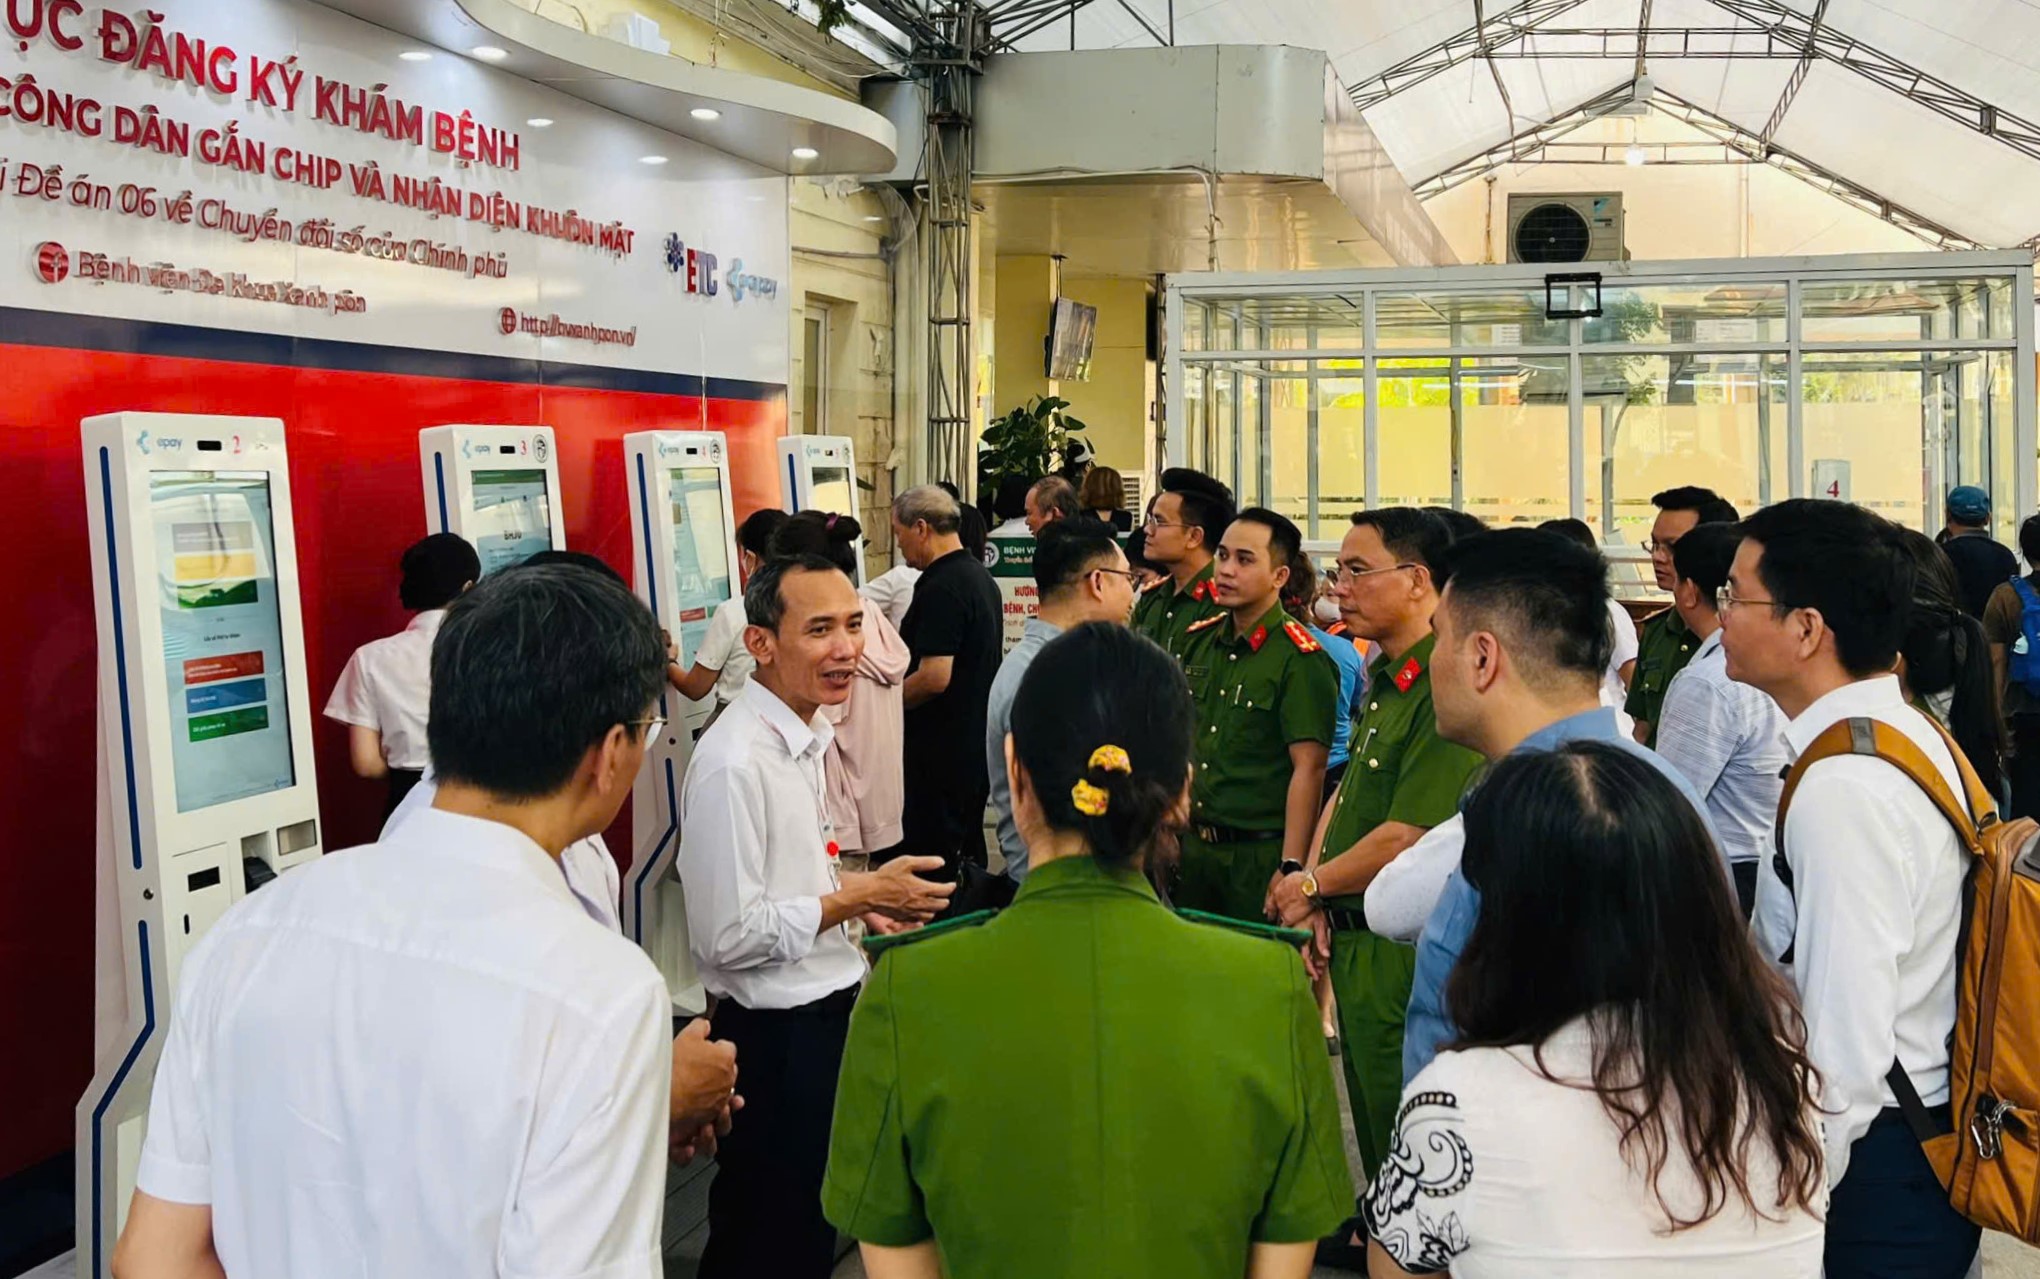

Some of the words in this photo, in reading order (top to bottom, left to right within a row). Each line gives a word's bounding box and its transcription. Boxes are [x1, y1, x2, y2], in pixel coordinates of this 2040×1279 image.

[98, 8, 237, 94] ĐĂNG
[250, 55, 304, 111] KÝ
[314, 75, 423, 146] KHÁM
[433, 109, 520, 171] BỆNH
[113, 104, 189, 157] DÂN
[199, 119, 265, 174] GẮN
[274, 147, 342, 189] CHIP
[349, 160, 386, 200] VÀ
[393, 174, 462, 220] NHẬN
[469, 191, 520, 233] DIỆN
[527, 204, 594, 246] KHUÔN
[599, 220, 635, 260] MẶT
[16, 163, 63, 200] Đề
[70, 174, 111, 210] án
[119, 184, 157, 217] 06
[410, 238, 468, 273] Chính
[472, 252, 508, 279] phủ
[76, 251, 140, 285] Bệnh
[686, 248, 718, 297] ETC
[233, 435, 241, 454] 2
[1826, 480, 1840, 498] 4
